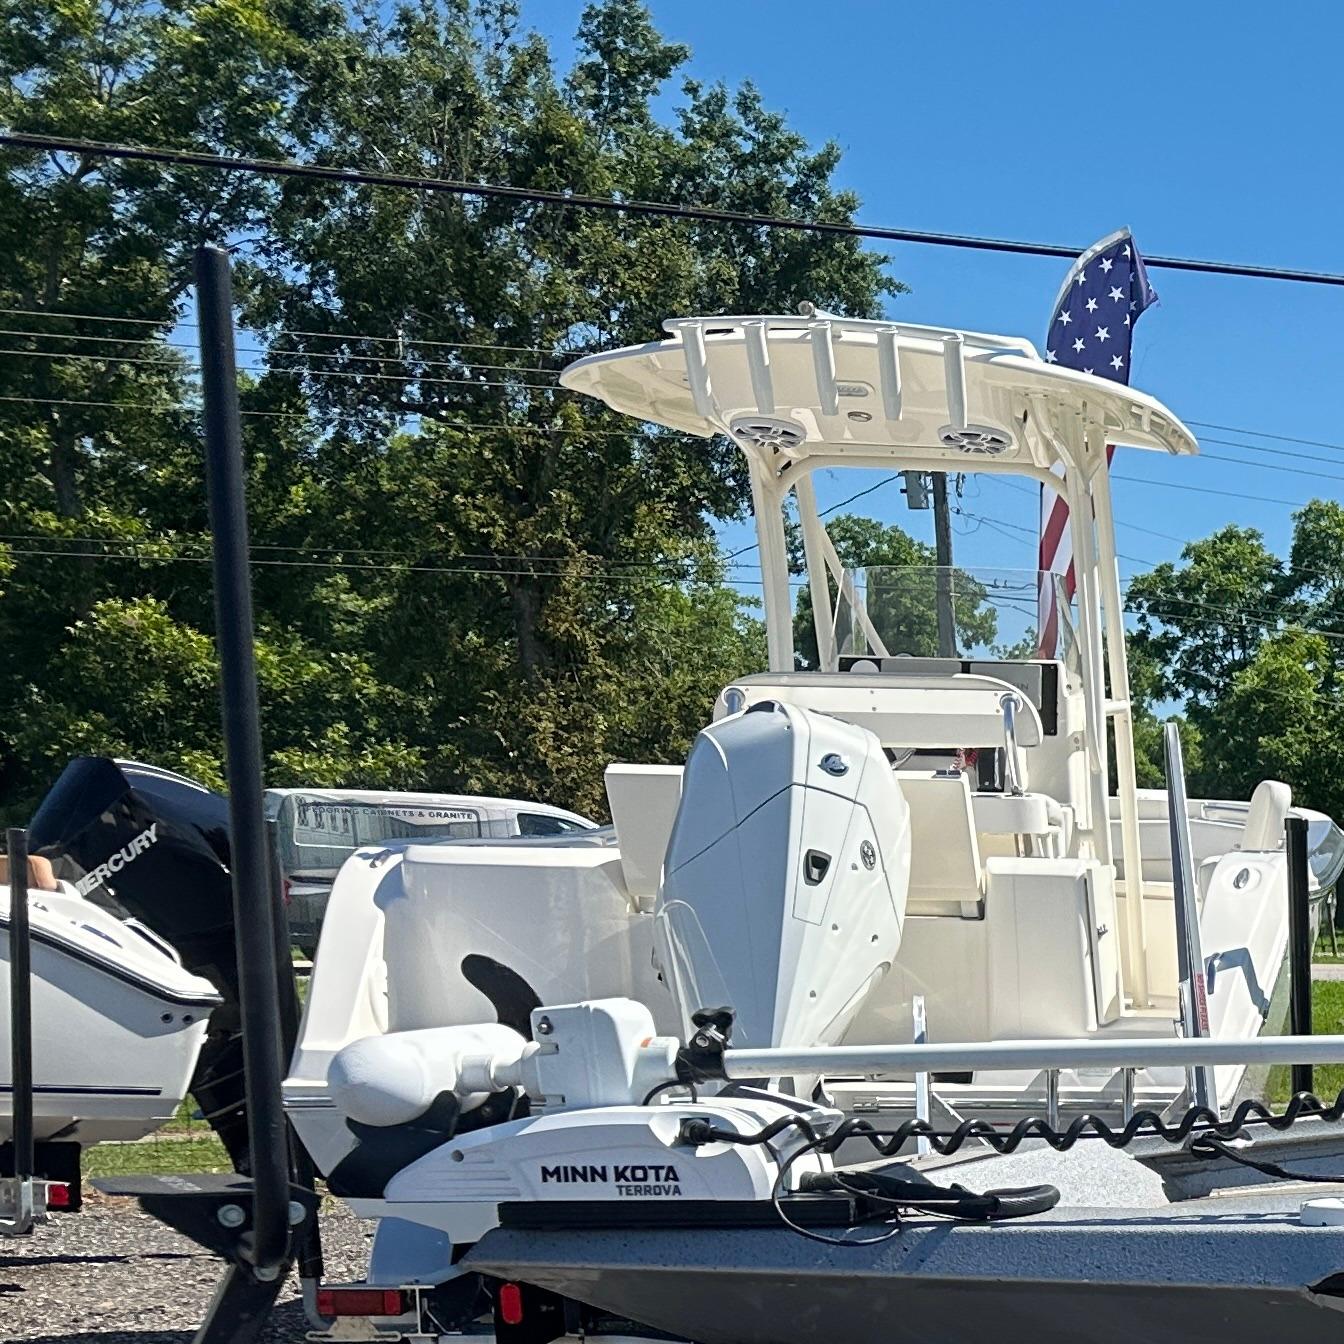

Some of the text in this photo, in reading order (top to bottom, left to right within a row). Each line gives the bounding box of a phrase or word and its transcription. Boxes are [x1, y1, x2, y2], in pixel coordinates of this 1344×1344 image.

[428, 811, 474, 820] GRANITE
[540, 1165, 680, 1183] MINN KOTA
[615, 1184, 683, 1197] TERROVA
